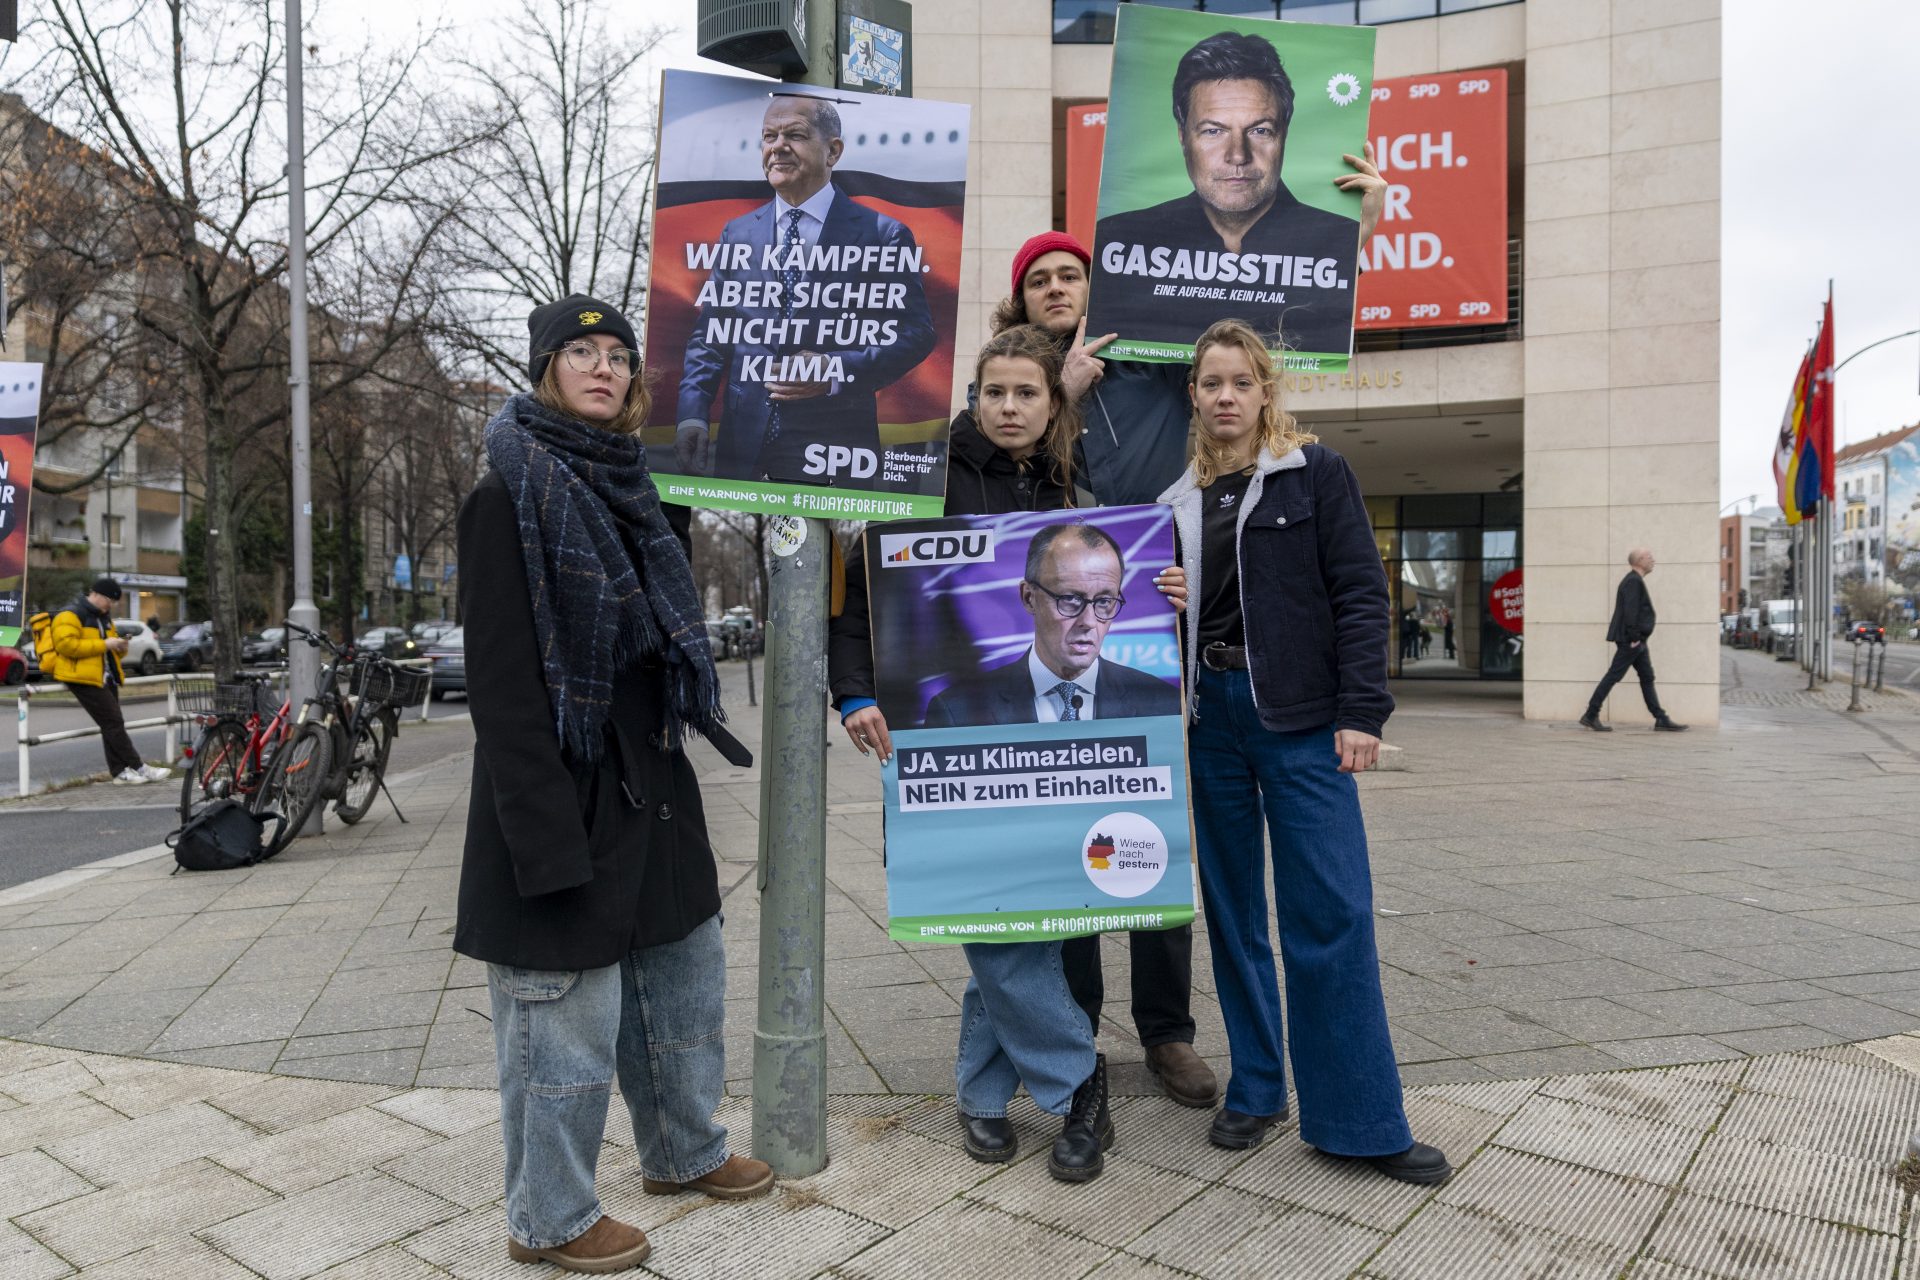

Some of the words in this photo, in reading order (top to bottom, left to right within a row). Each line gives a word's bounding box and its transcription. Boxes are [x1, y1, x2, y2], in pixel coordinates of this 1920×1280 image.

[1371, 88, 1391, 101] PD
[1409, 83, 1441, 99] SPD
[1459, 79, 1491, 95] SPD
[1372, 131, 1468, 172] ICH.
[686, 242, 753, 270] WIR
[761, 237, 930, 273] KÄMPFEN.
[1101, 241, 1348, 289] GASAUSSTIEG.
[694, 280, 784, 308] ABER
[792, 281, 907, 310] SICHER
[1153, 284, 1177, 296] EINE
[1177, 285, 1227, 300] AUFGABE.
[1229, 289, 1255, 302] KEIN
[1254, 290, 1286, 304] PLAN.
[1361, 306, 1391, 321] SPD
[1409, 303, 1441, 318] SPD
[1459, 301, 1491, 316] SPD
[705, 317, 810, 345] NICHT
[816, 312, 899, 346] FÜRS
[1110, 346, 1131, 355] EINE
[1134, 347, 1184, 359] WARNUNG
[740, 355, 855, 383] KLIMA.
[1285, 368, 1404, 393] NDT-HAUS
[802, 443, 878, 479] SPD
[883, 461, 915, 473] Planet
[916, 464, 932, 474] für
[884, 450, 938, 464] Sterbender
[883, 471, 907, 482] Dich.
[669, 485, 695, 496] EINE
[698, 487, 758, 501] WARNUNG
[761, 492, 786, 504] VON
[793, 492, 913, 516] #FRIDAYSFORFUTURE
[911, 534, 988, 560] CDU
[1503, 596, 1523, 608] Poli
[903, 751, 939, 774] JA
[945, 754, 976, 772] zu
[982, 743, 1142, 770] Klimazielen,
[905, 781, 967, 804] NEIN
[973, 784, 1028, 801] zum
[1035, 774, 1167, 798] Einhalten.
[1119, 838, 1156, 849] Wieder
[1119, 850, 1144, 859] nach
[1118, 860, 1159, 870] gestern
[920, 926, 945, 936] EINE
[948, 922, 1007, 935] WARNUNG
[1010, 921, 1035, 932] VON
[1041, 913, 1163, 933] #FRIDAYSFORFUTURE
